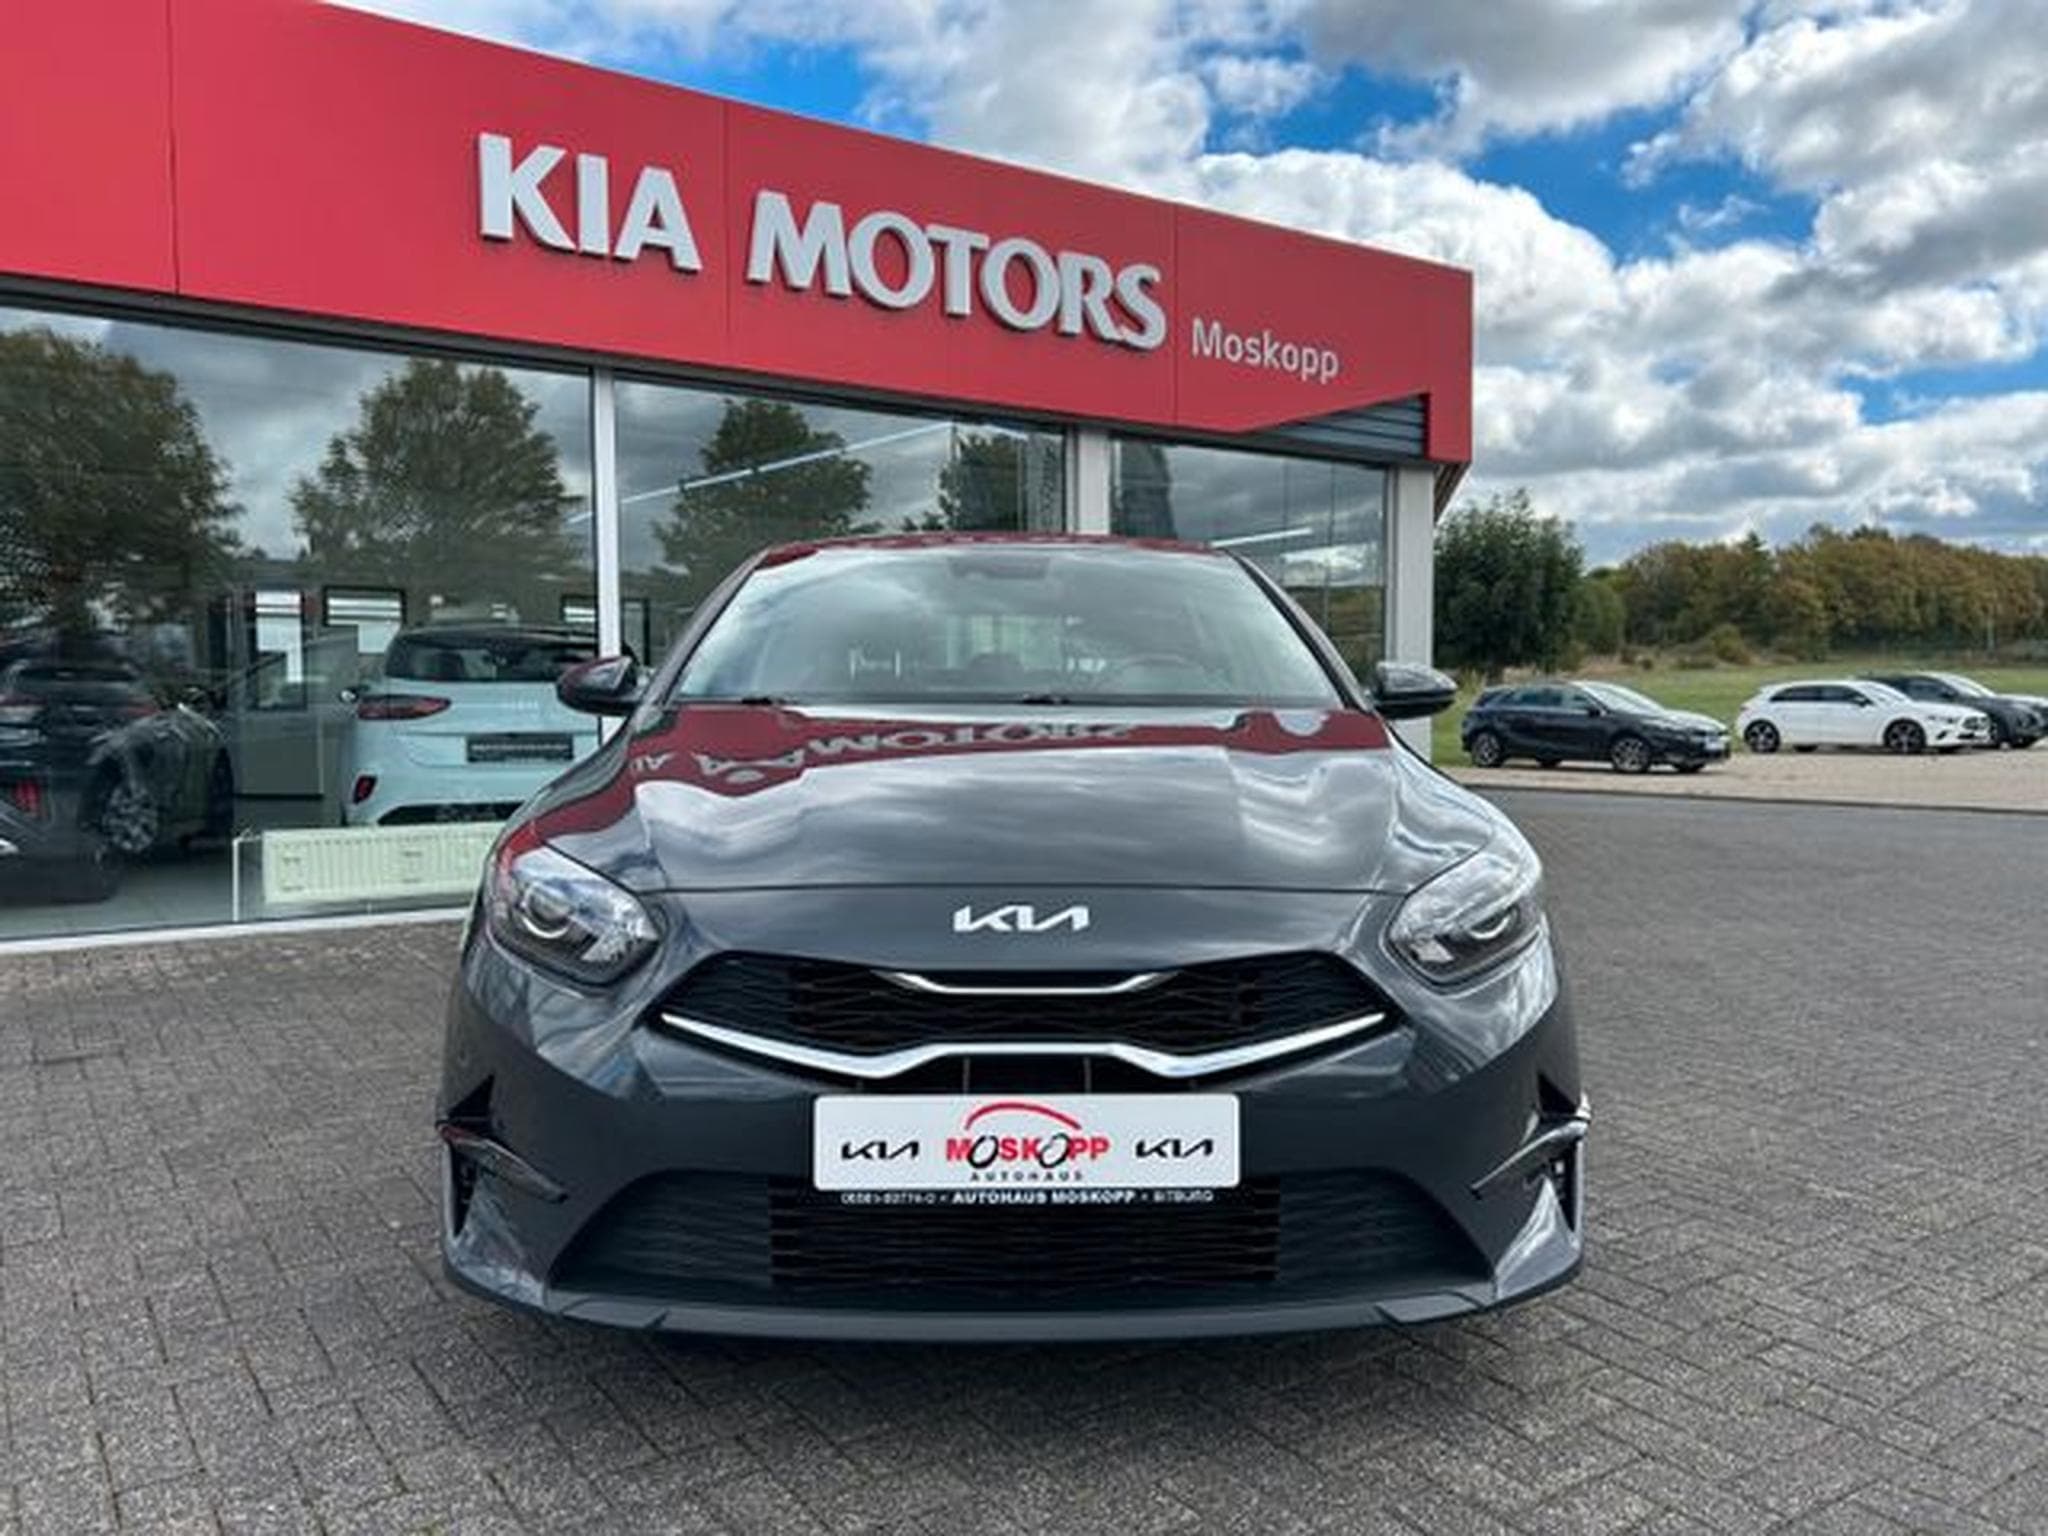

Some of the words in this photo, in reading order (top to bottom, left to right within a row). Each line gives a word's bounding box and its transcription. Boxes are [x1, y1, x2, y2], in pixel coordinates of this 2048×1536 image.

[477, 132, 702, 272] KIA
[746, 190, 1168, 350] MOTORS
[1191, 316, 1341, 385] Moskopp
[953, 905, 1089, 933] KIA
[840, 1141, 919, 1161] KIA
[946, 1132, 1111, 1169] MOSKOPP
[1134, 1138, 1214, 1161] KIA
[969, 1171, 1084, 1182] AUTOHAUS
[952, 1190, 1047, 1205] AUTOHAUS
[1051, 1189, 1136, 1204] MOSKOPP
